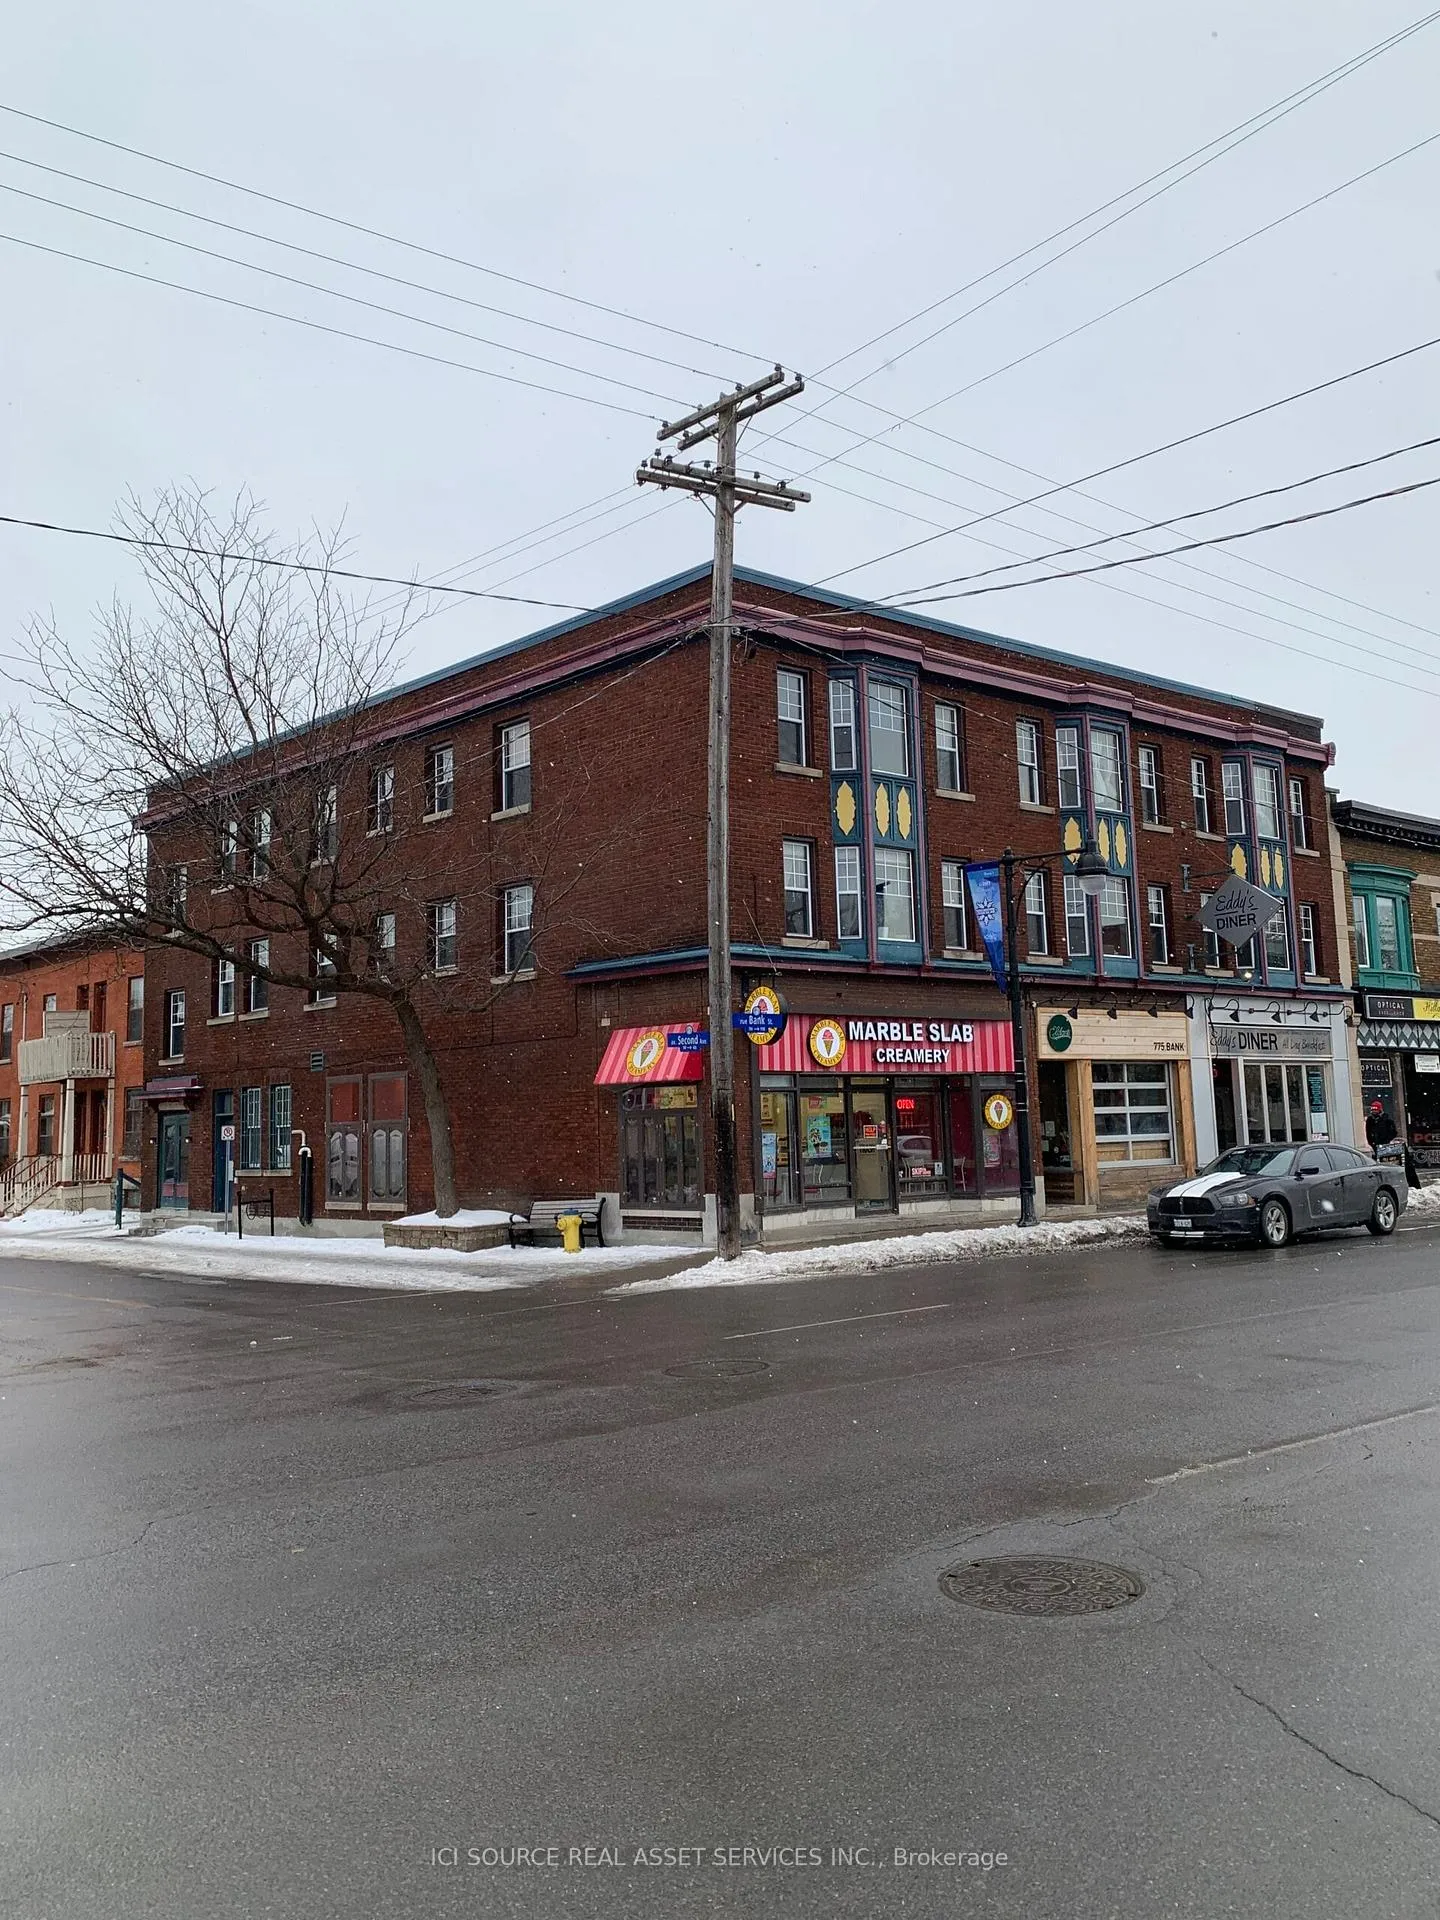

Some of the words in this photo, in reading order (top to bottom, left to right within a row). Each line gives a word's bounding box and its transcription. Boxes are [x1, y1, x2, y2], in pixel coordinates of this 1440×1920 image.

[1216, 889, 1255, 914] Eddy's
[1216, 913, 1257, 930] DINER
[1377, 1001, 1405, 1009] OPTICAL
[749, 1015, 766, 1025] Bank
[849, 1021, 924, 1041] MARBLE
[929, 1023, 974, 1042] SLAB
[678, 1034, 699, 1046] Second
[1153, 1042, 1164, 1051] 775
[1166, 1043, 1185, 1051] BANK
[1238, 1032, 1278, 1050] DINER
[876, 1048, 950, 1063] CREAMERY
[896, 1099, 915, 1110] OPEN
